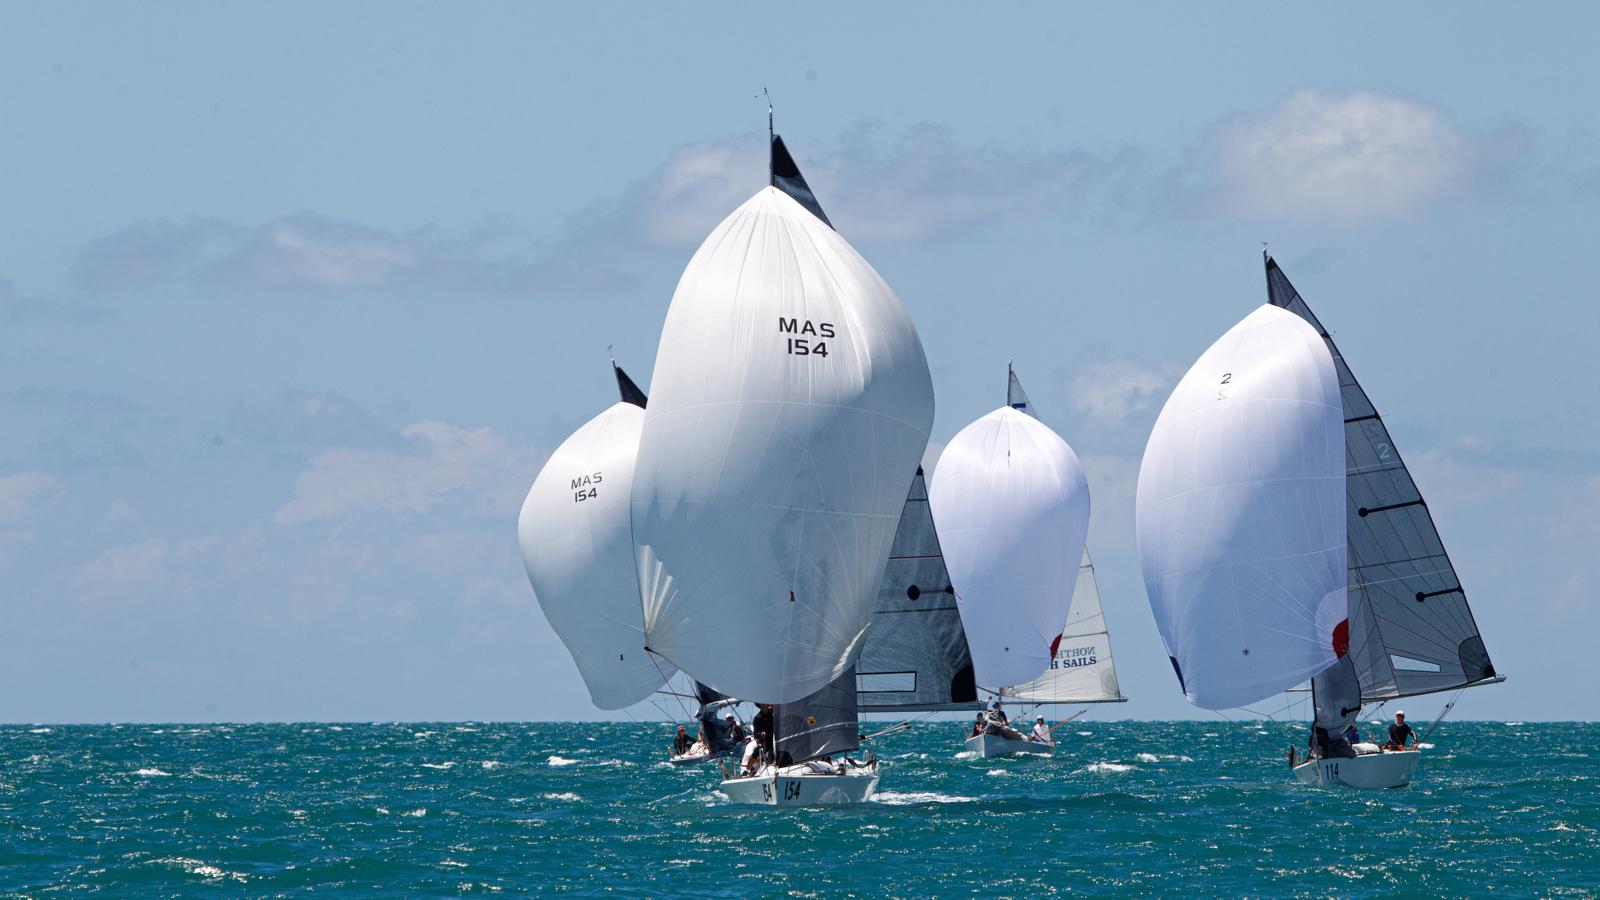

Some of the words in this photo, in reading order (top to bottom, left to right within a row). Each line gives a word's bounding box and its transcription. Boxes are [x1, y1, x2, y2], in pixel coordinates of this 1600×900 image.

[779, 317, 835, 338] MAS
[788, 338, 828, 357] 154
[1220, 373, 1231, 384] 2
[1378, 443, 1391, 459] 2
[571, 471, 602, 490] MAS
[575, 487, 597, 502] 154
[1063, 656, 1097, 668] SAILS
[1325, 763, 1339, 780] 114
[784, 781, 801, 800] 154
